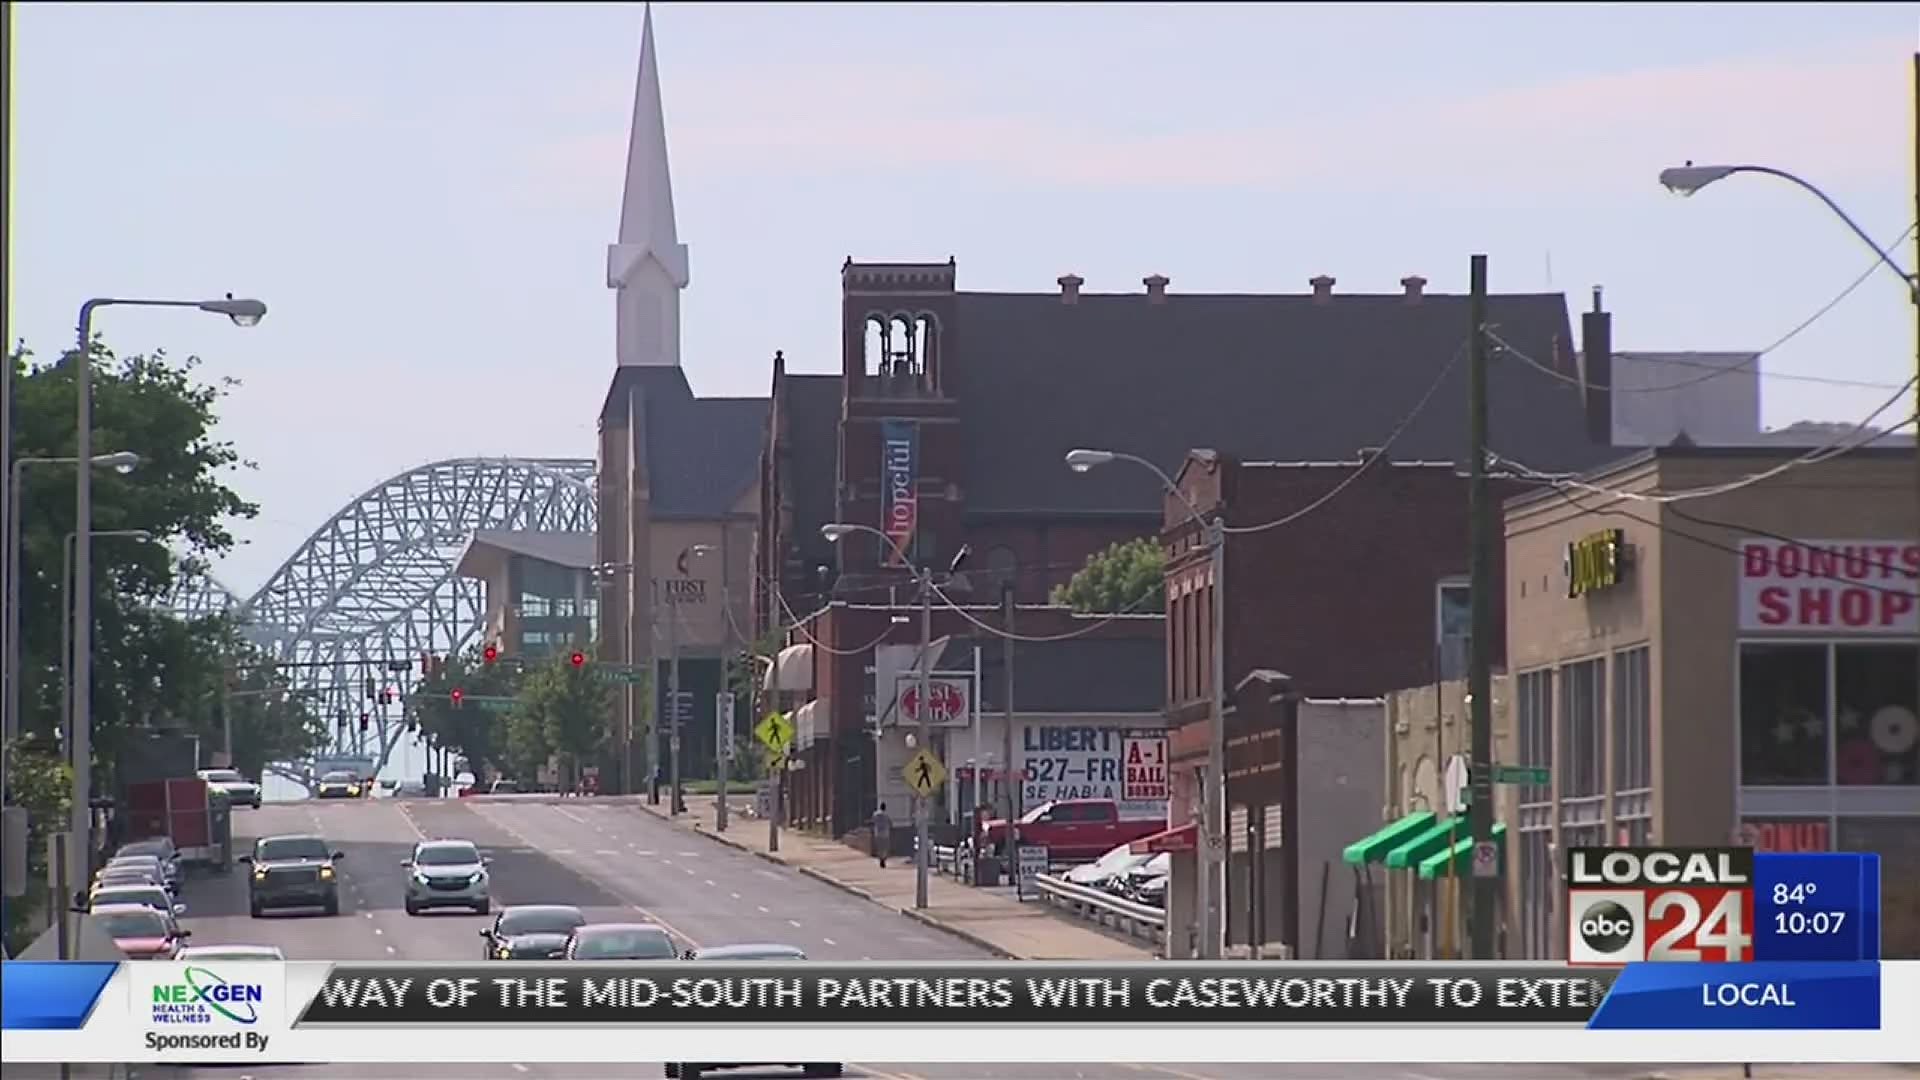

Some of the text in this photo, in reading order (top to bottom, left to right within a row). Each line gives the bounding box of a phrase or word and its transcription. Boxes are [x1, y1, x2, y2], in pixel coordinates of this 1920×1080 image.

[886, 440, 916, 537] hopeful
[1744, 544, 1920, 579] DONUTS
[665, 579, 707, 593] FIRST
[1758, 586, 1912, 626] SHOP
[1024, 726, 1121, 751] LIBERT
[1127, 741, 1164, 764] A-1
[1025, 757, 1122, 782] 527-FR
[1127, 767, 1165, 783] BAIL
[1025, 785, 1047, 799] SE
